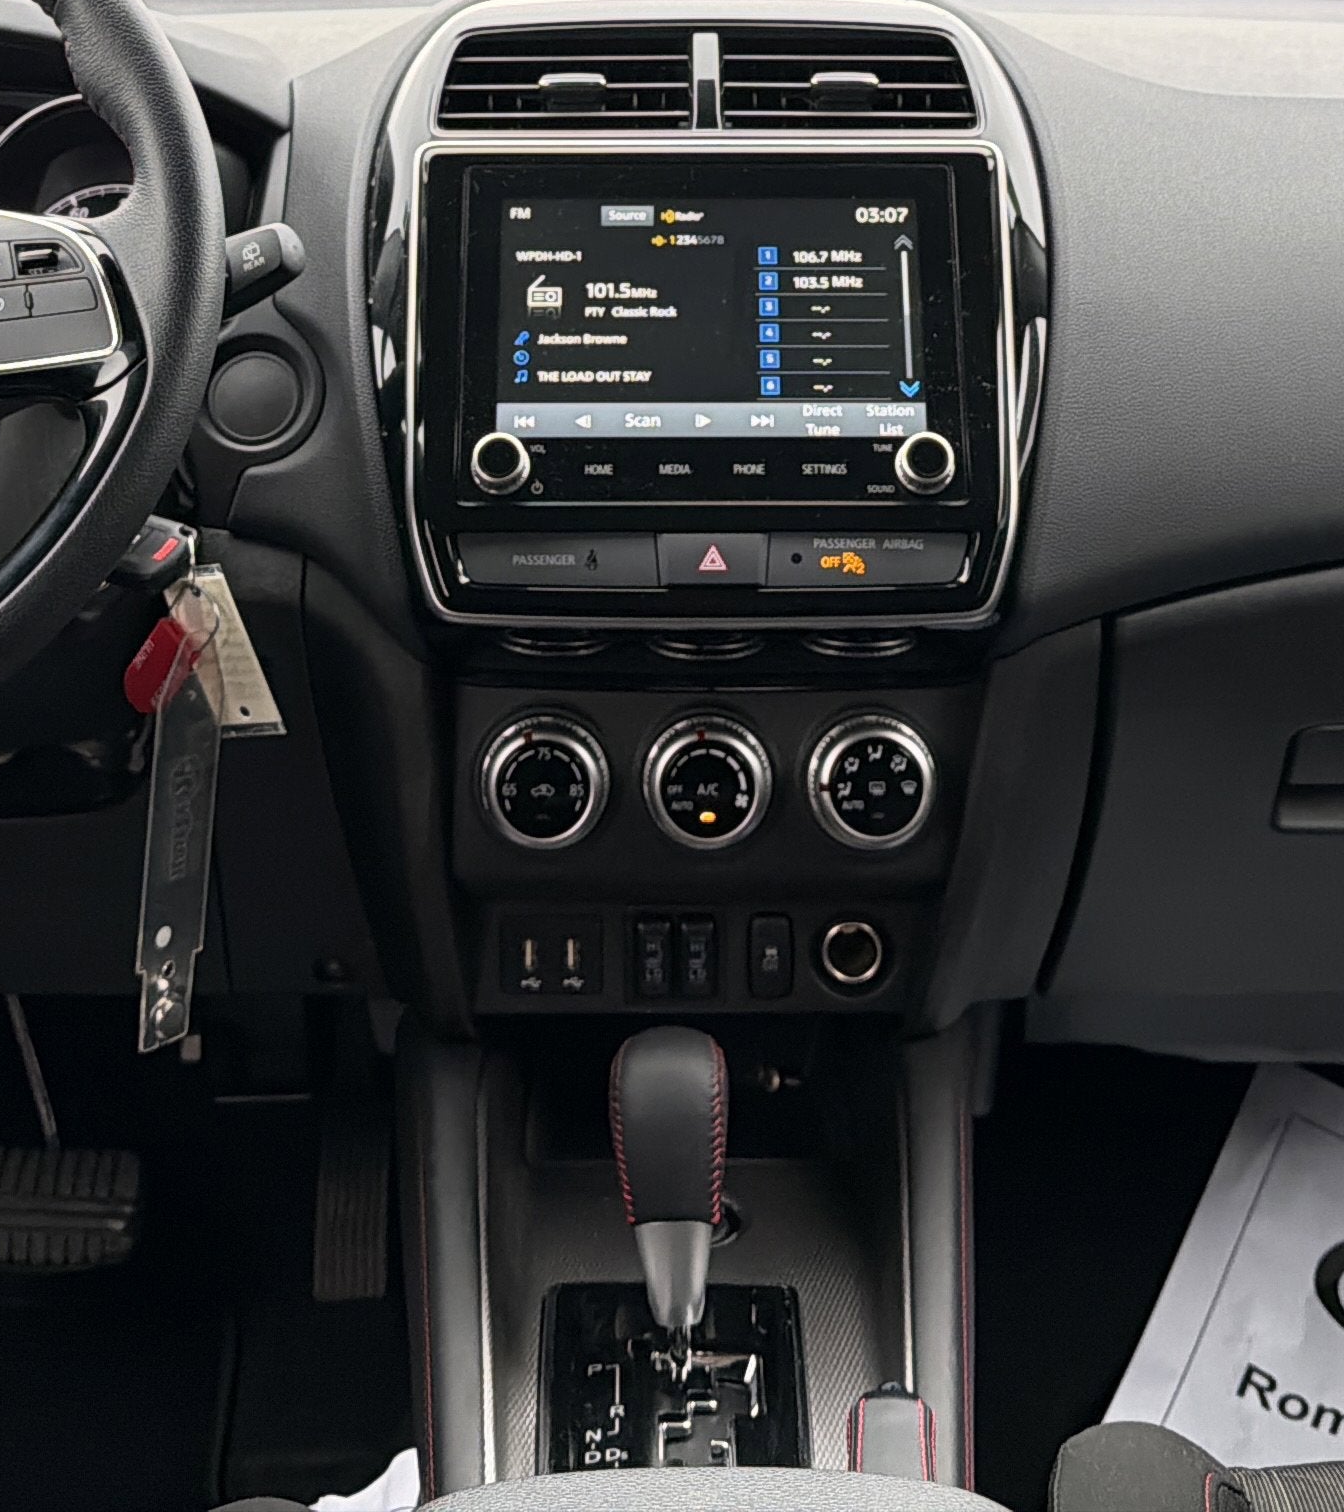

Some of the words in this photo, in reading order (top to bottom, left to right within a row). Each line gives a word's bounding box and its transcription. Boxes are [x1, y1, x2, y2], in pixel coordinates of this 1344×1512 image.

[509, 206, 532, 220] FM
[608, 209, 647, 222] Source
[855, 206, 909, 224] 03:07
[792, 250, 829, 263] 106.7
[830, 249, 863, 263] MHz
[243, 256, 266, 272] REAR
[792, 276, 830, 289] 103.5
[831, 275, 864, 288] MHz
[611, 305, 648, 318] Classic
[649, 305, 678, 318] Rock
[537, 333, 582, 346] Jackson
[583, 333, 628, 345] Browne
[537, 370, 560, 383] THE
[561, 370, 595, 383] LOAD
[595, 370, 621, 383] OUT
[622, 370, 653, 383] STAY
[802, 404, 843, 418] Direct
[865, 404, 915, 418] Station
[624, 412, 662, 428] Scan
[805, 423, 841, 436] Tune
[879, 423, 904, 436] List
[584, 463, 614, 476] HOME
[659, 463, 692, 476] MEDIA
[732, 463, 766, 476] PHONE
[801, 463, 848, 476] SETTINGS
[813, 537, 877, 549] PASSENGER
[882, 538, 924, 550] AIRBAG
[512, 553, 577, 567] PASSENGER
[820, 555, 842, 568] OFF
[536, 747, 552, 761] 75
[569, 784, 585, 796] 85
[697, 783, 719, 796] A/C
[587, 1363, 603, 1377] P
[609, 1403, 626, 1418] R
[585, 1428, 601, 1444] N
[584, 1450, 602, 1465] D
